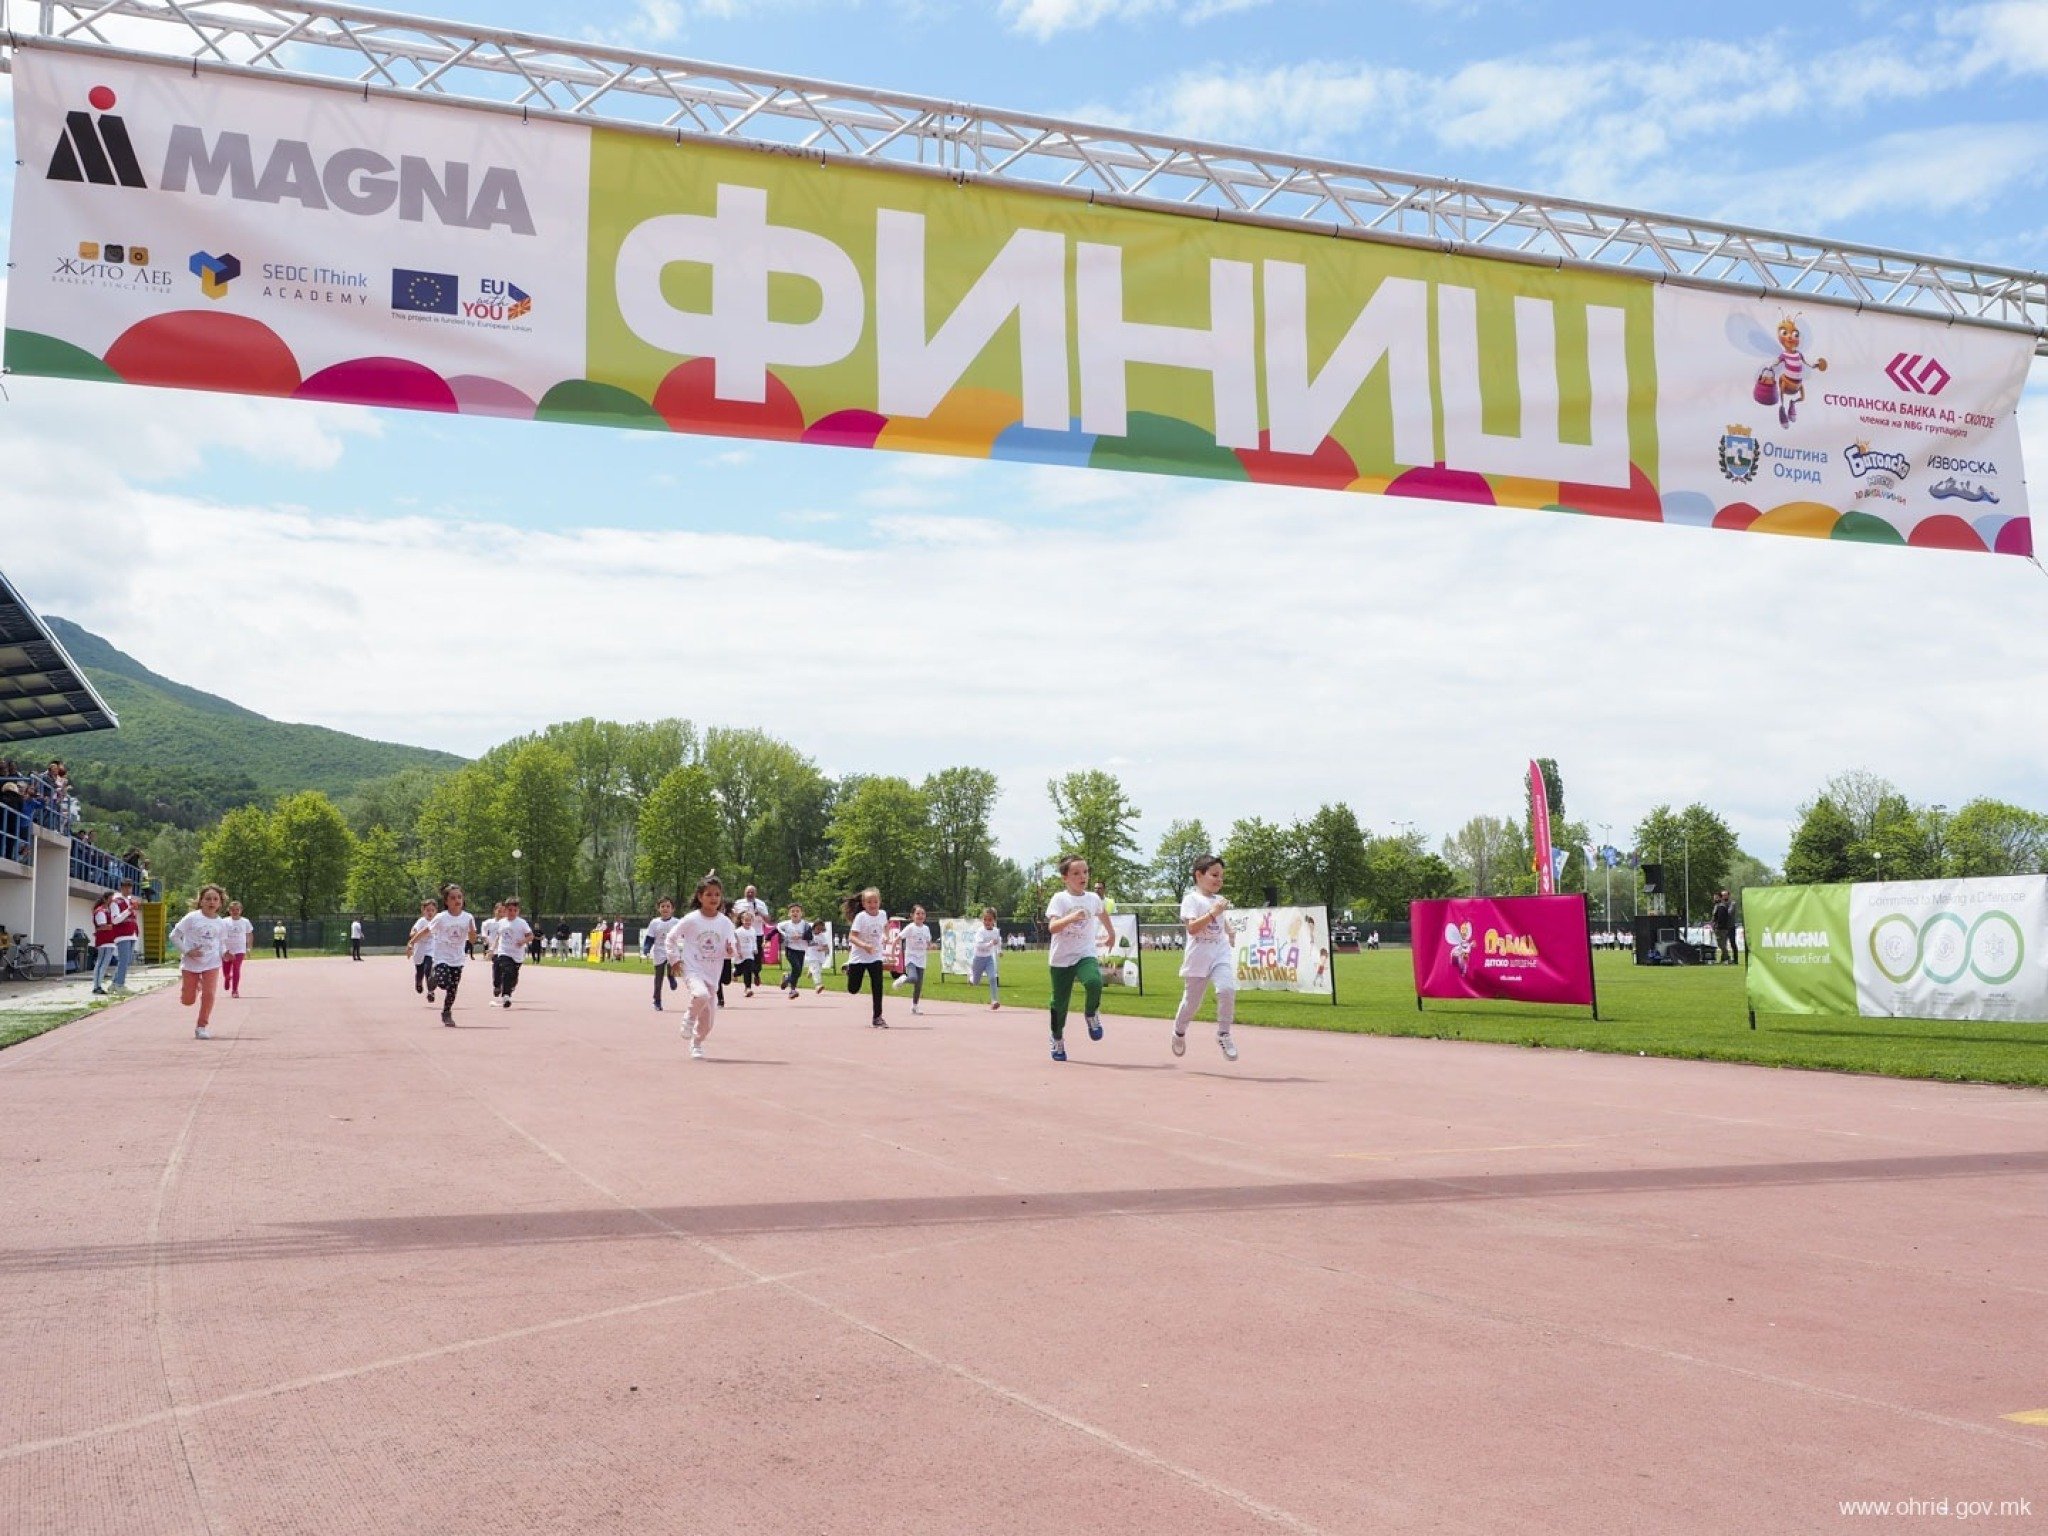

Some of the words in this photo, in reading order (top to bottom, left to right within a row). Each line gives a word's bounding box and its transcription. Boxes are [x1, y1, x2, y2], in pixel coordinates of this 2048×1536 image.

[160, 124, 537, 236] MAGNA
[54, 257, 124, 281] ЖИТО
[134, 268, 172, 286] ЛЕБ
[262, 264, 308, 283] SEDC
[314, 268, 368, 287] IThink
[262, 286, 368, 306] ACADEMY
[481, 278, 504, 295] EU
[462, 301, 503, 321] YOU
[391, 312, 406, 321] This
[407, 313, 432, 323] project
[441, 316, 466, 326] funded
[477, 320, 511, 331] European
[512, 323, 533, 333] Union
[614, 183, 1631, 490] ФИНИШ
[1824, 393, 1897, 413] СТОПАНСКА
[1899, 402, 1936, 419] БАНКА
[1939, 409, 1955, 424] АД
[1964, 412, 1996, 429] СКОПЈЕ
[1859, 415, 1890, 427] членка
[1891, 419, 1902, 429] на
[1904, 420, 1923, 432] NBG
[1763, 441, 1828, 463] Општина
[1774, 463, 1822, 484] Охрид
[1926, 454, 1998, 476] ИЗВОРСКА
[1774, 931, 1830, 948] MAGNA
